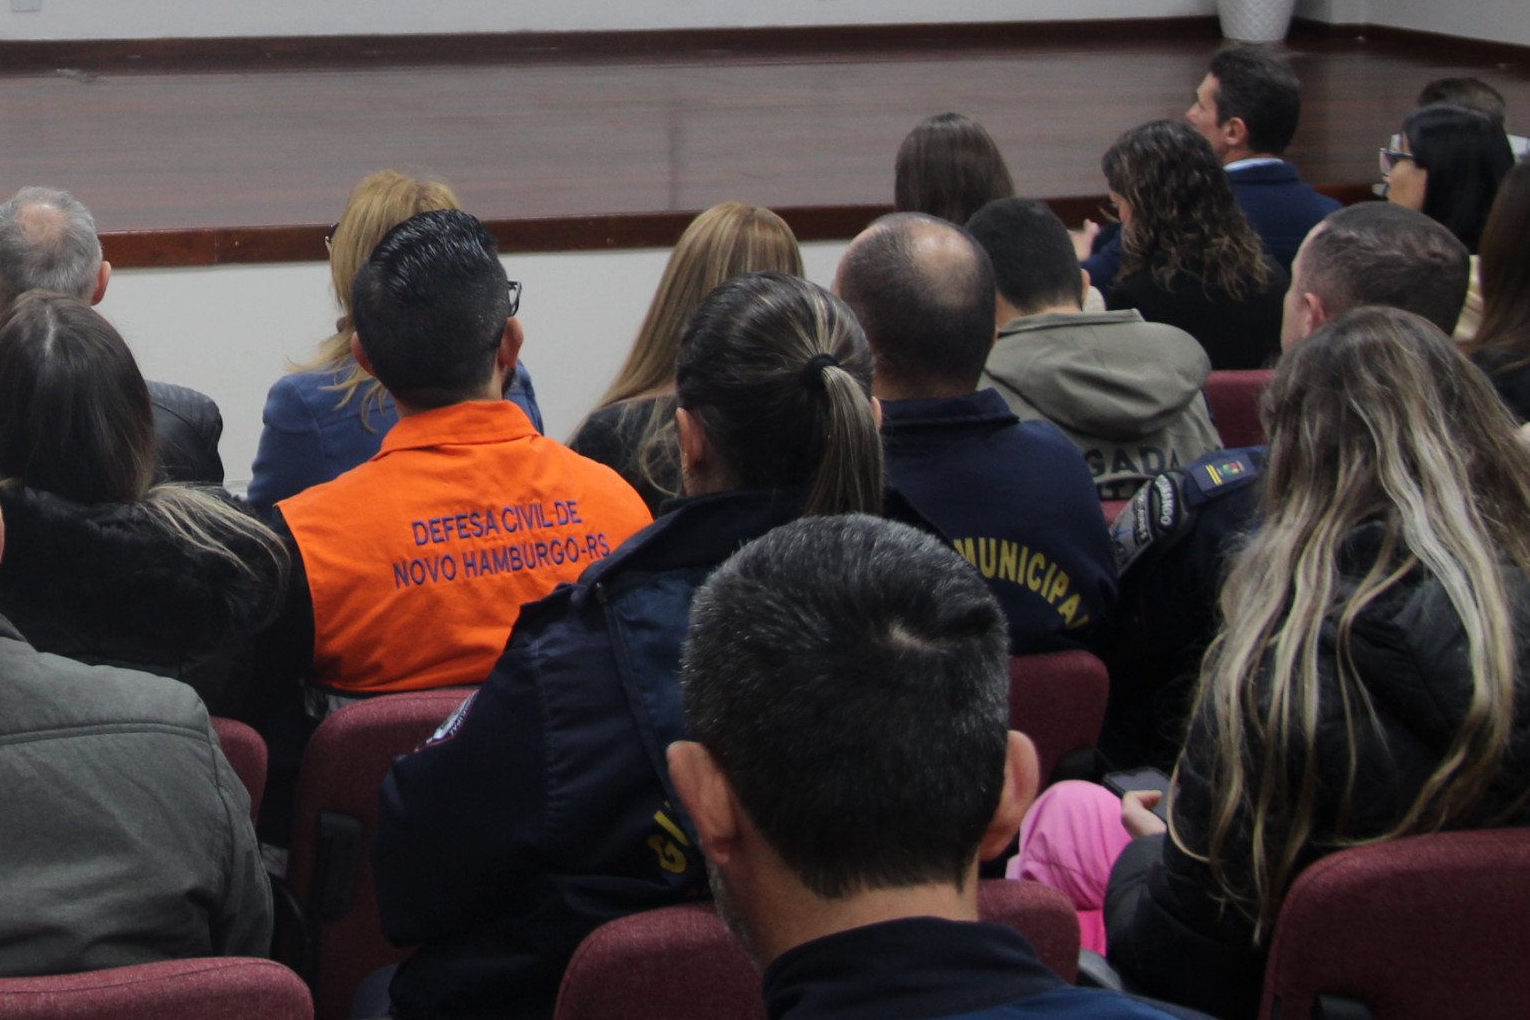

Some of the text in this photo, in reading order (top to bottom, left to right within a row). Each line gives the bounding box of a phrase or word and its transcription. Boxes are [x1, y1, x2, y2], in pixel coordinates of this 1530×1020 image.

[411, 499, 582, 547] DEFESA CIVIL DE
[392, 532, 611, 590] NOVO HAMBURGO-RS
